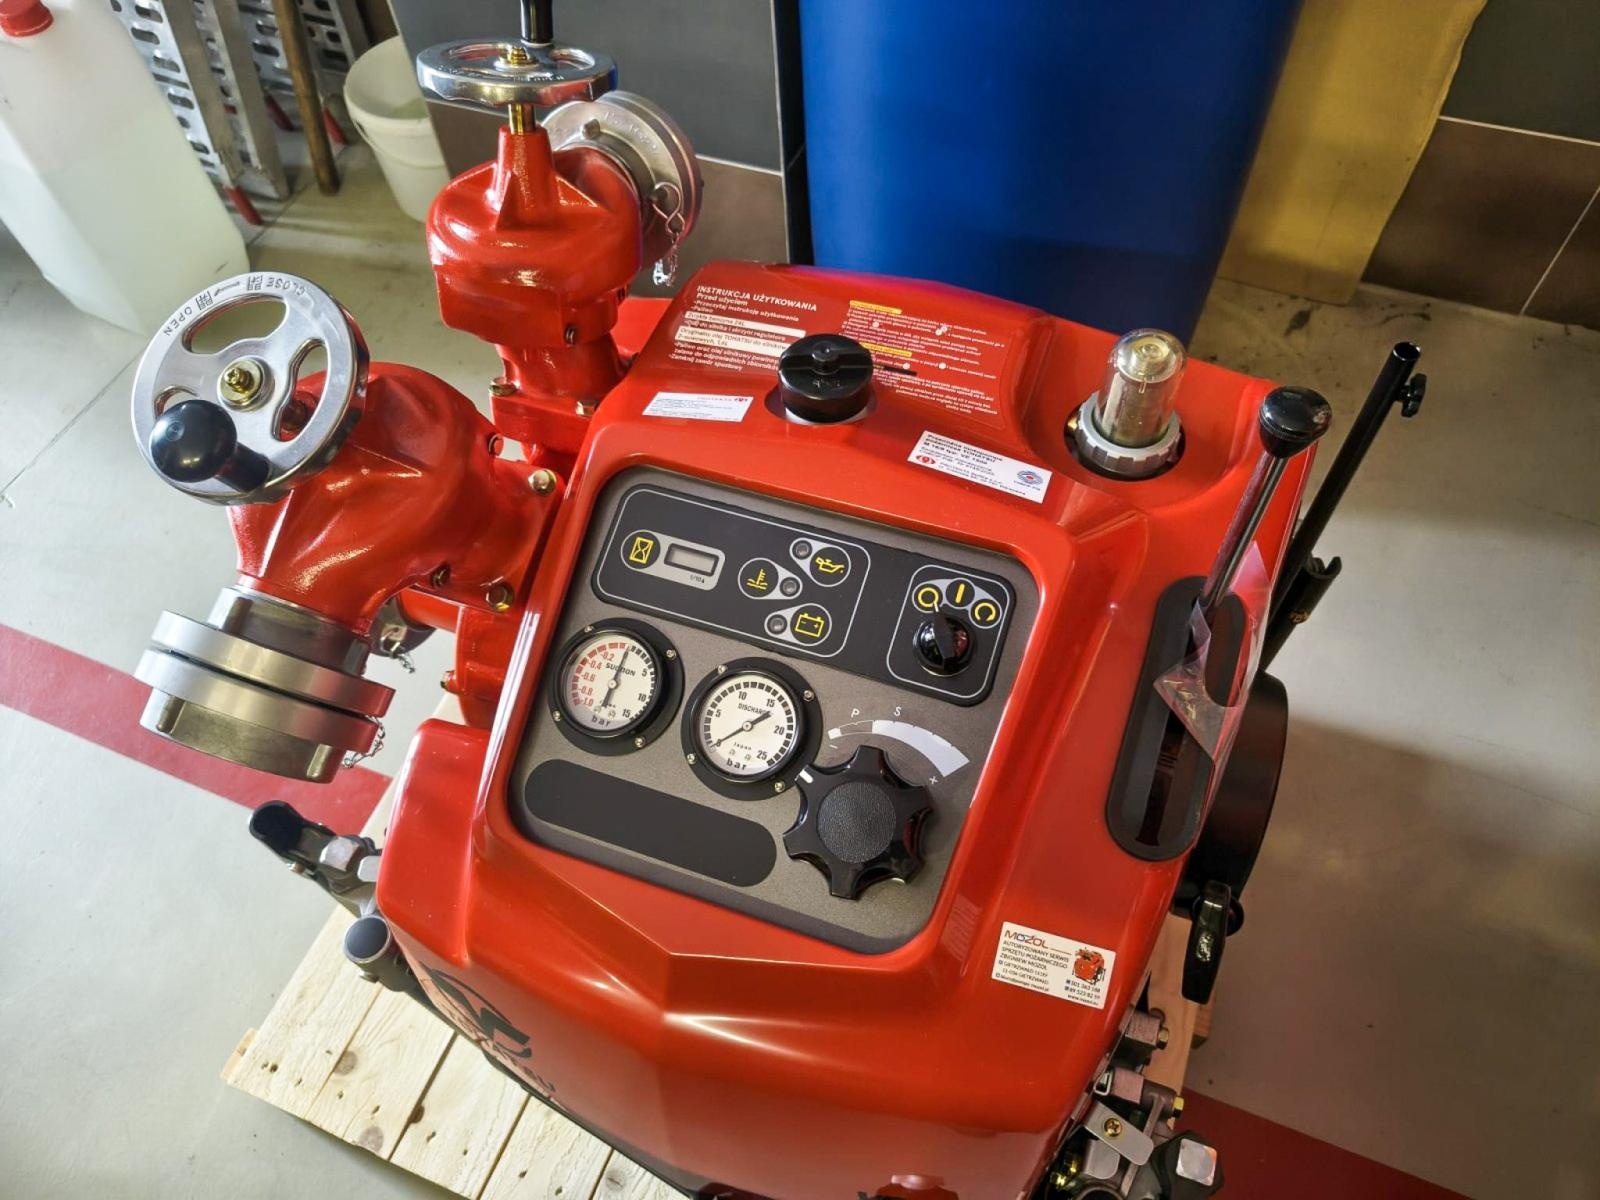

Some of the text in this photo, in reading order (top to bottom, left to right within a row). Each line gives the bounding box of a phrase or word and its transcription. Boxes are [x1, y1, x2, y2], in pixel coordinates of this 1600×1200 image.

[266, 276, 306, 296] CLOSE
[696, 285, 817, 312] INSTRUKCJA UŻYTKOWANIA
[696, 292, 748, 306] Przed użyciem
[164, 306, 193, 336] OPEN
[641, 669, 648, 678] 5
[638, 693, 647, 702] 10
[738, 691, 748, 701] 10
[766, 698, 776, 708] 15
[622, 708, 631, 718] 15
[715, 709, 722, 718] 5
[738, 703, 771, 715] DISCHAR
[850, 708, 860, 718] P
[893, 706, 903, 717] S
[591, 715, 611, 727] bar
[773, 725, 785, 736] 20
[756, 750, 768, 760] 25
[726, 757, 747, 770] bar
